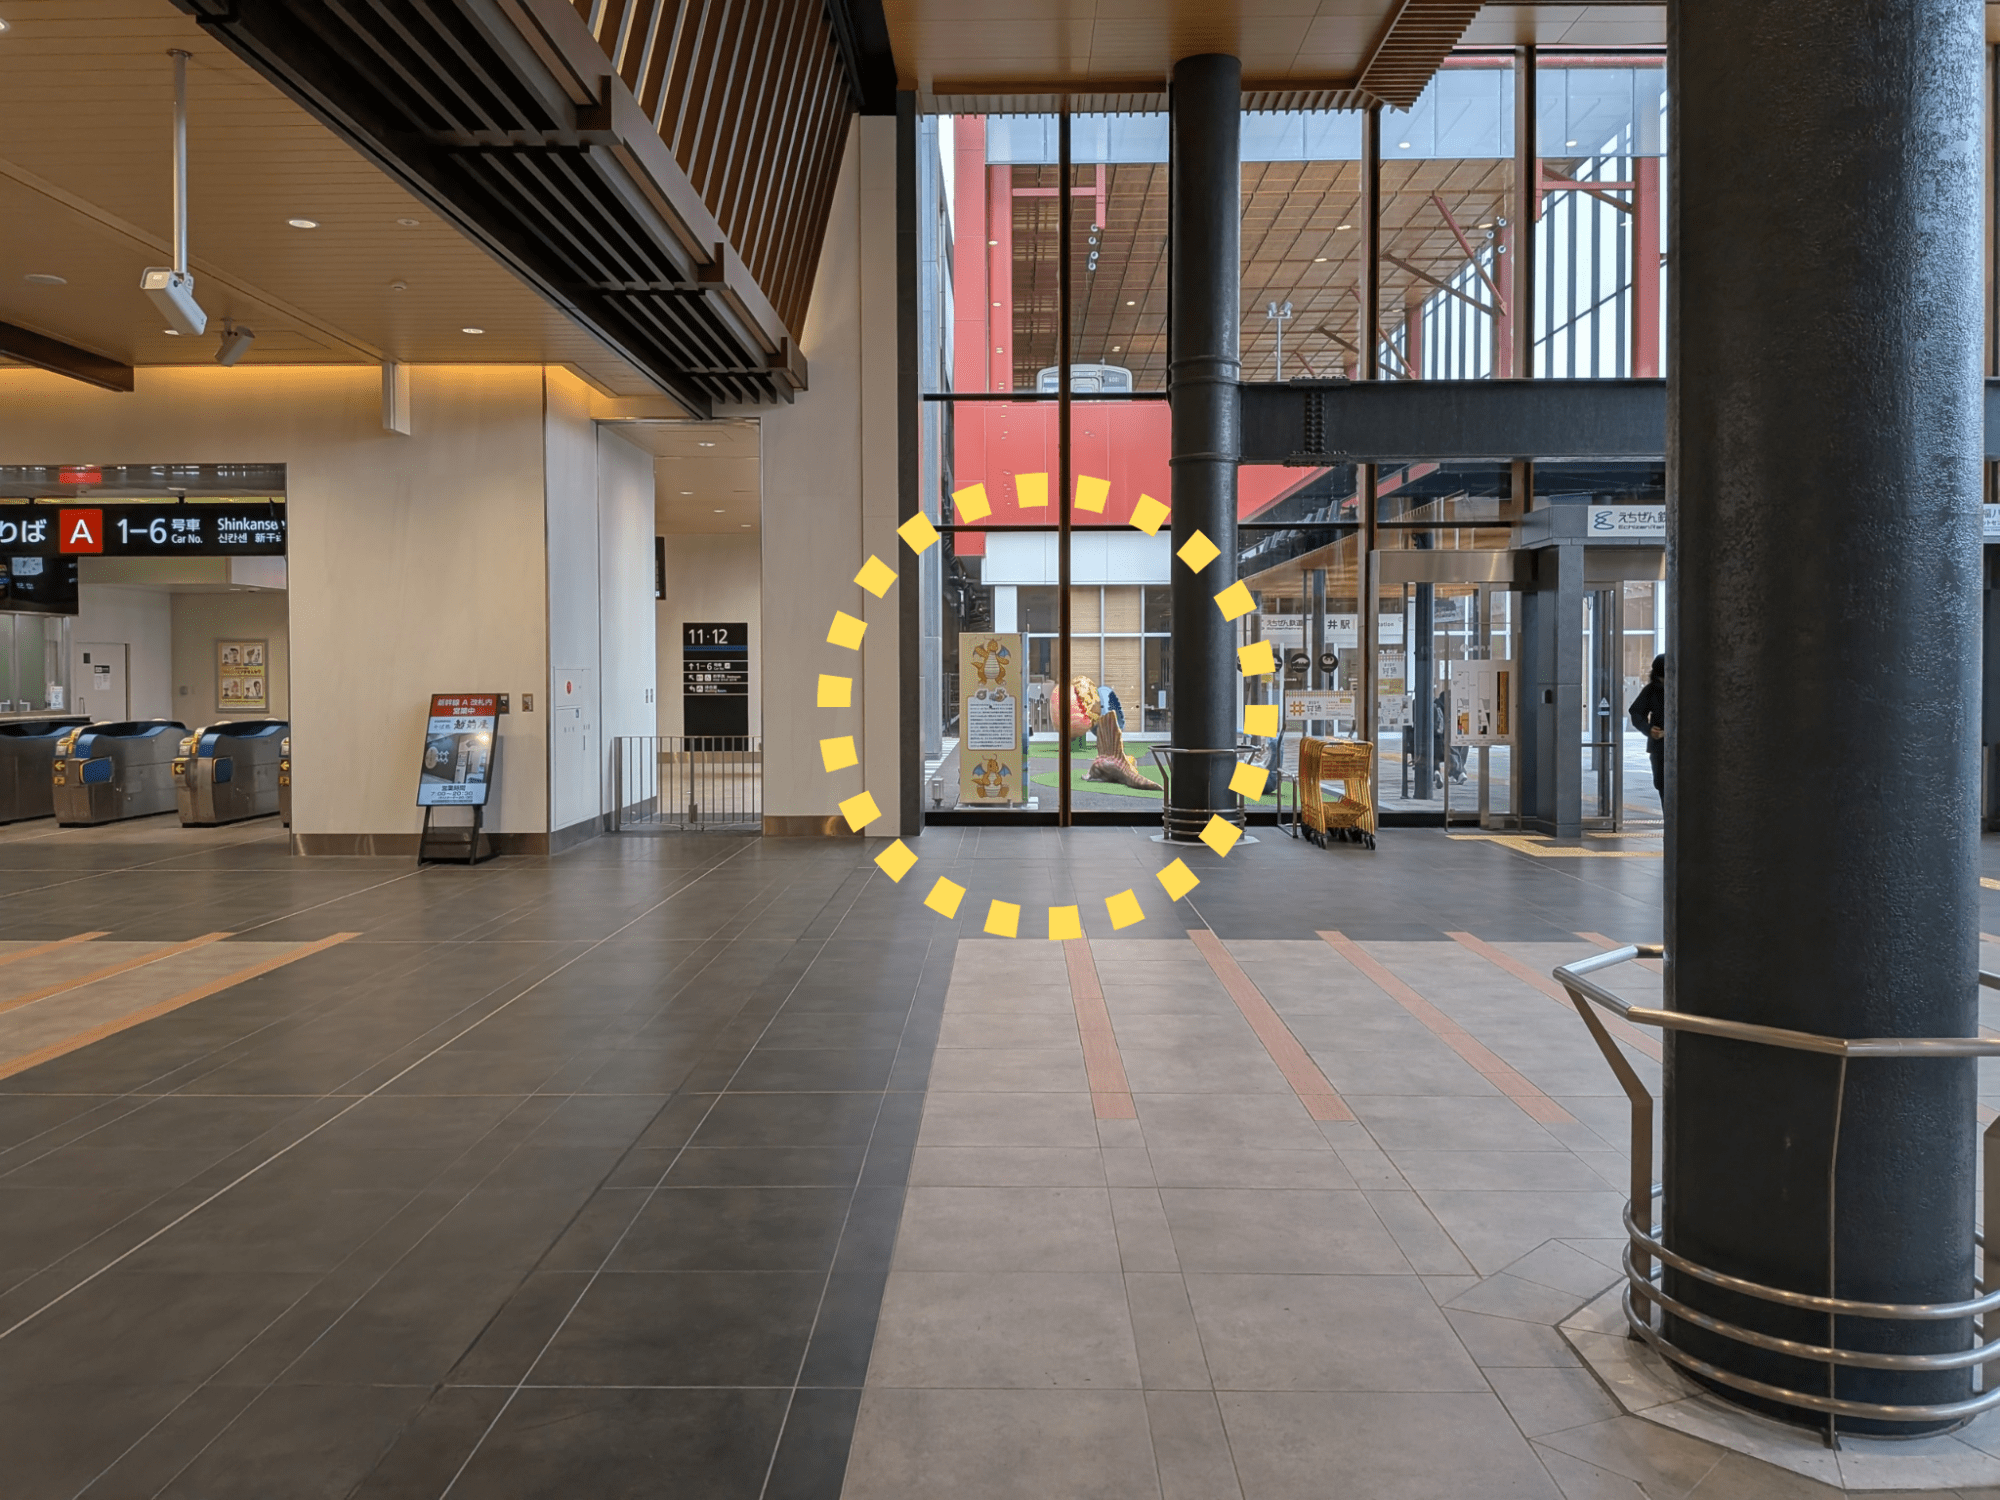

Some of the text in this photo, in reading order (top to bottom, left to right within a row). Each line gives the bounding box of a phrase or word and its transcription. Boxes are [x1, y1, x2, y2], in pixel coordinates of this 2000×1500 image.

[0, 518, 48, 544] りば
[69, 518, 94, 544] A
[171, 518, 201, 532] 号車
[171, 534, 203, 544] Car No.
[218, 533, 248, 544] 신칸센
